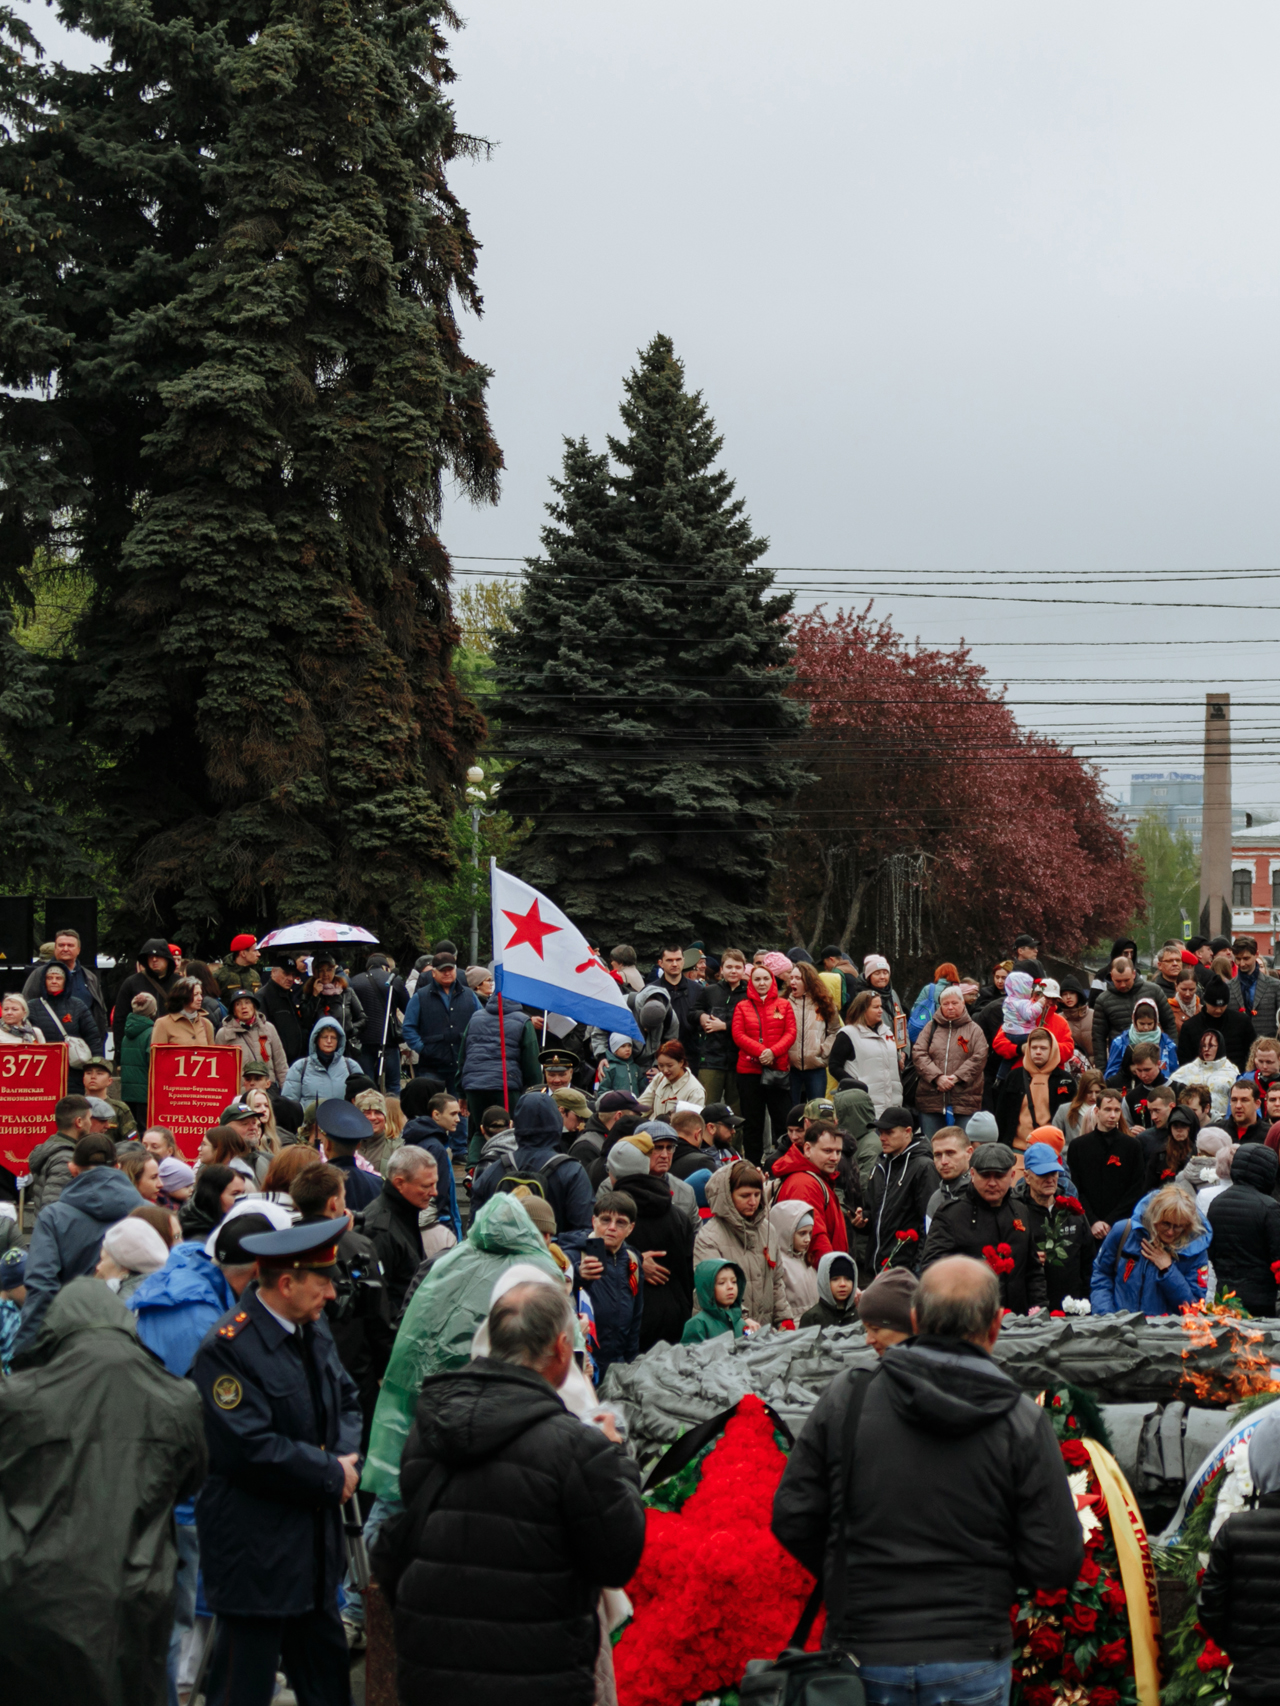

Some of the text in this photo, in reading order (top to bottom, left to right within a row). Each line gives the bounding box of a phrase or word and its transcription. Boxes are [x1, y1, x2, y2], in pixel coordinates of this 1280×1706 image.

[1, 1054, 48, 1078] 377
[174, 1055, 220, 1078] 171
[158, 1114, 221, 1124] СТРЕЛКОВА
